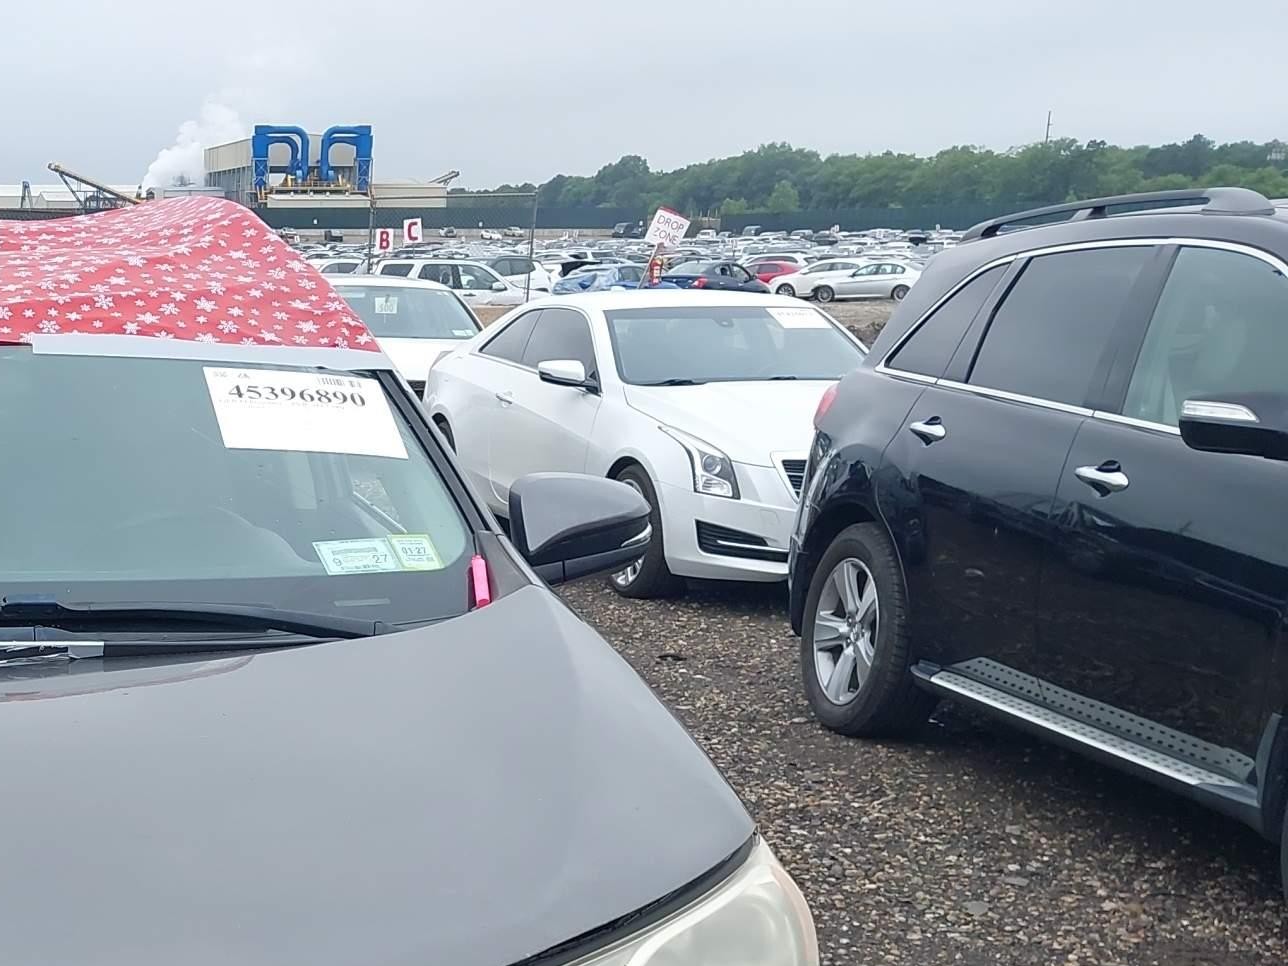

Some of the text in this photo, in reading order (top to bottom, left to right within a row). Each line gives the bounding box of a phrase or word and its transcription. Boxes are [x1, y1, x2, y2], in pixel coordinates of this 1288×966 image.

[407, 221, 418, 241] C
[657, 214, 684, 232] DROP
[379, 230, 390, 250] B
[652, 227, 679, 245] ZONE
[228, 384, 366, 407] 45396890
